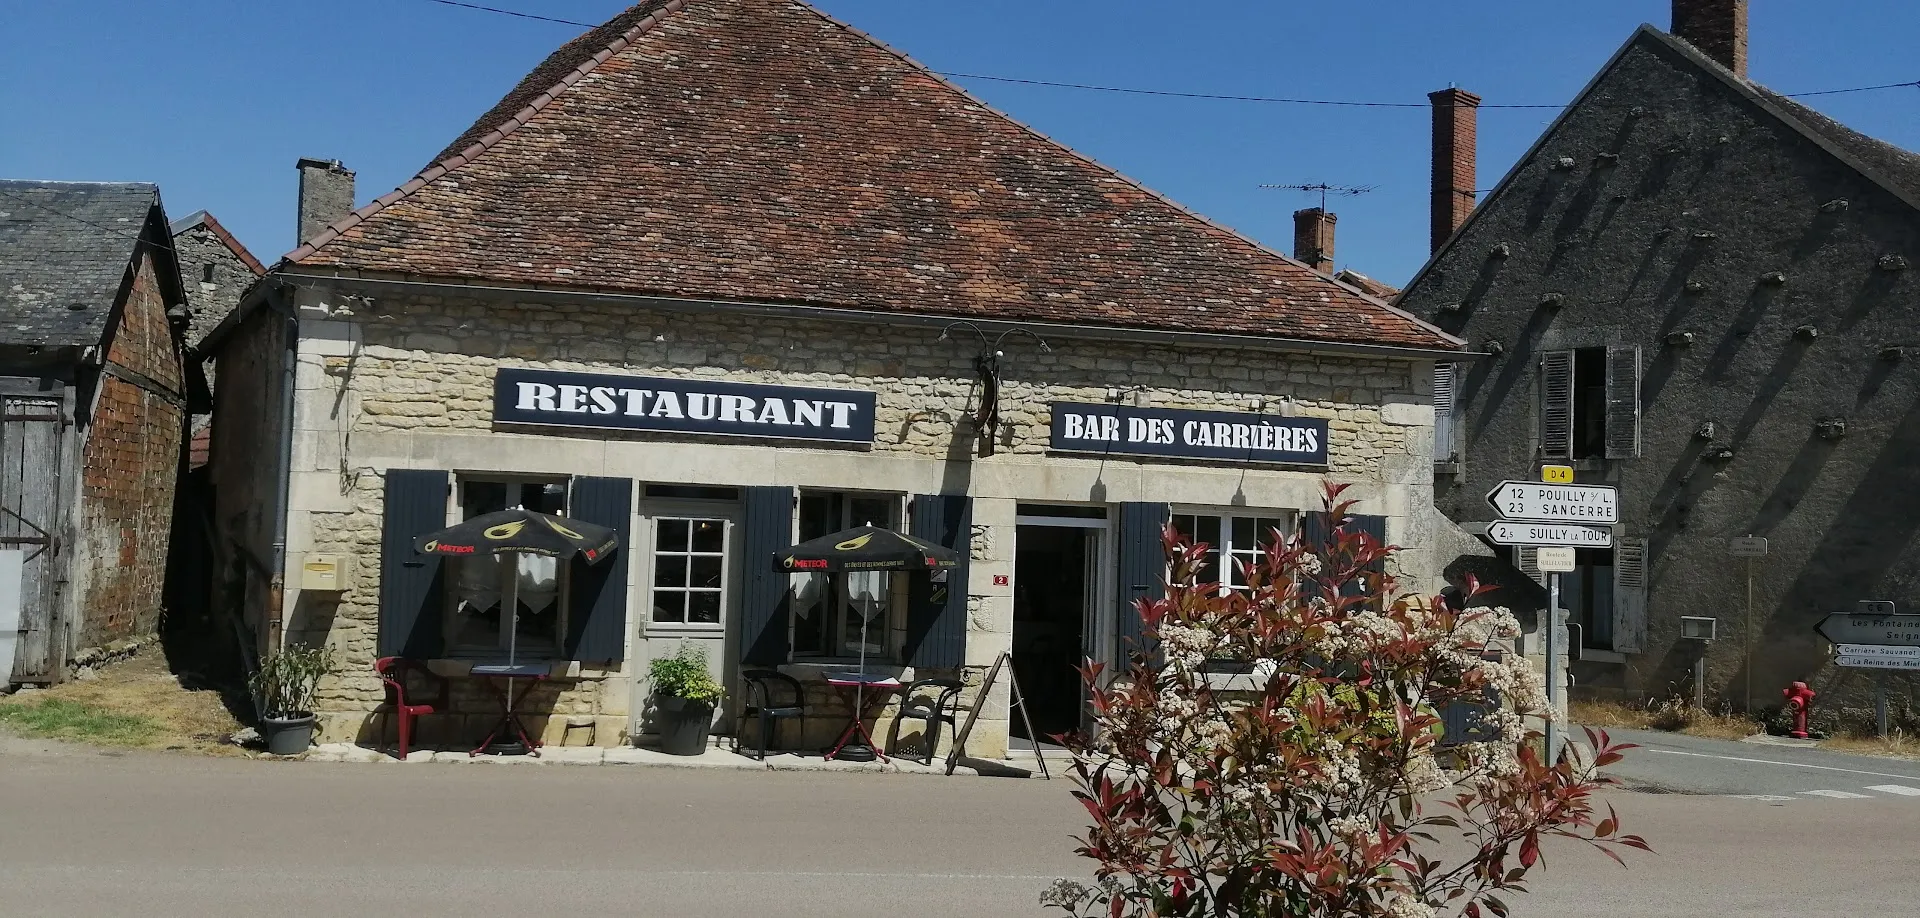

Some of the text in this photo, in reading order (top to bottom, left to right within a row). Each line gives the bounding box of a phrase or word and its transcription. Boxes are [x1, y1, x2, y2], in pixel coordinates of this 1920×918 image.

[514, 381, 857, 429] RESTAURANT
[1063, 413, 1319, 453] BAR DES CARRIÈRES
[1511, 488, 1524, 499] 12
[1539, 489, 1586, 502] POUILLY
[1603, 493, 1612, 503] L.
[1508, 502, 1612, 517] 23 SANCERRE
[1529, 528, 1568, 540] SUILLY
[1581, 530, 1607, 542] TOUR
[437, 543, 475, 553] METEOR
[794, 558, 828, 568] METEOR
[998, 576, 1004, 584] 2
[1863, 658, 1885, 666] Reine
[1887, 659, 1900, 667] des
